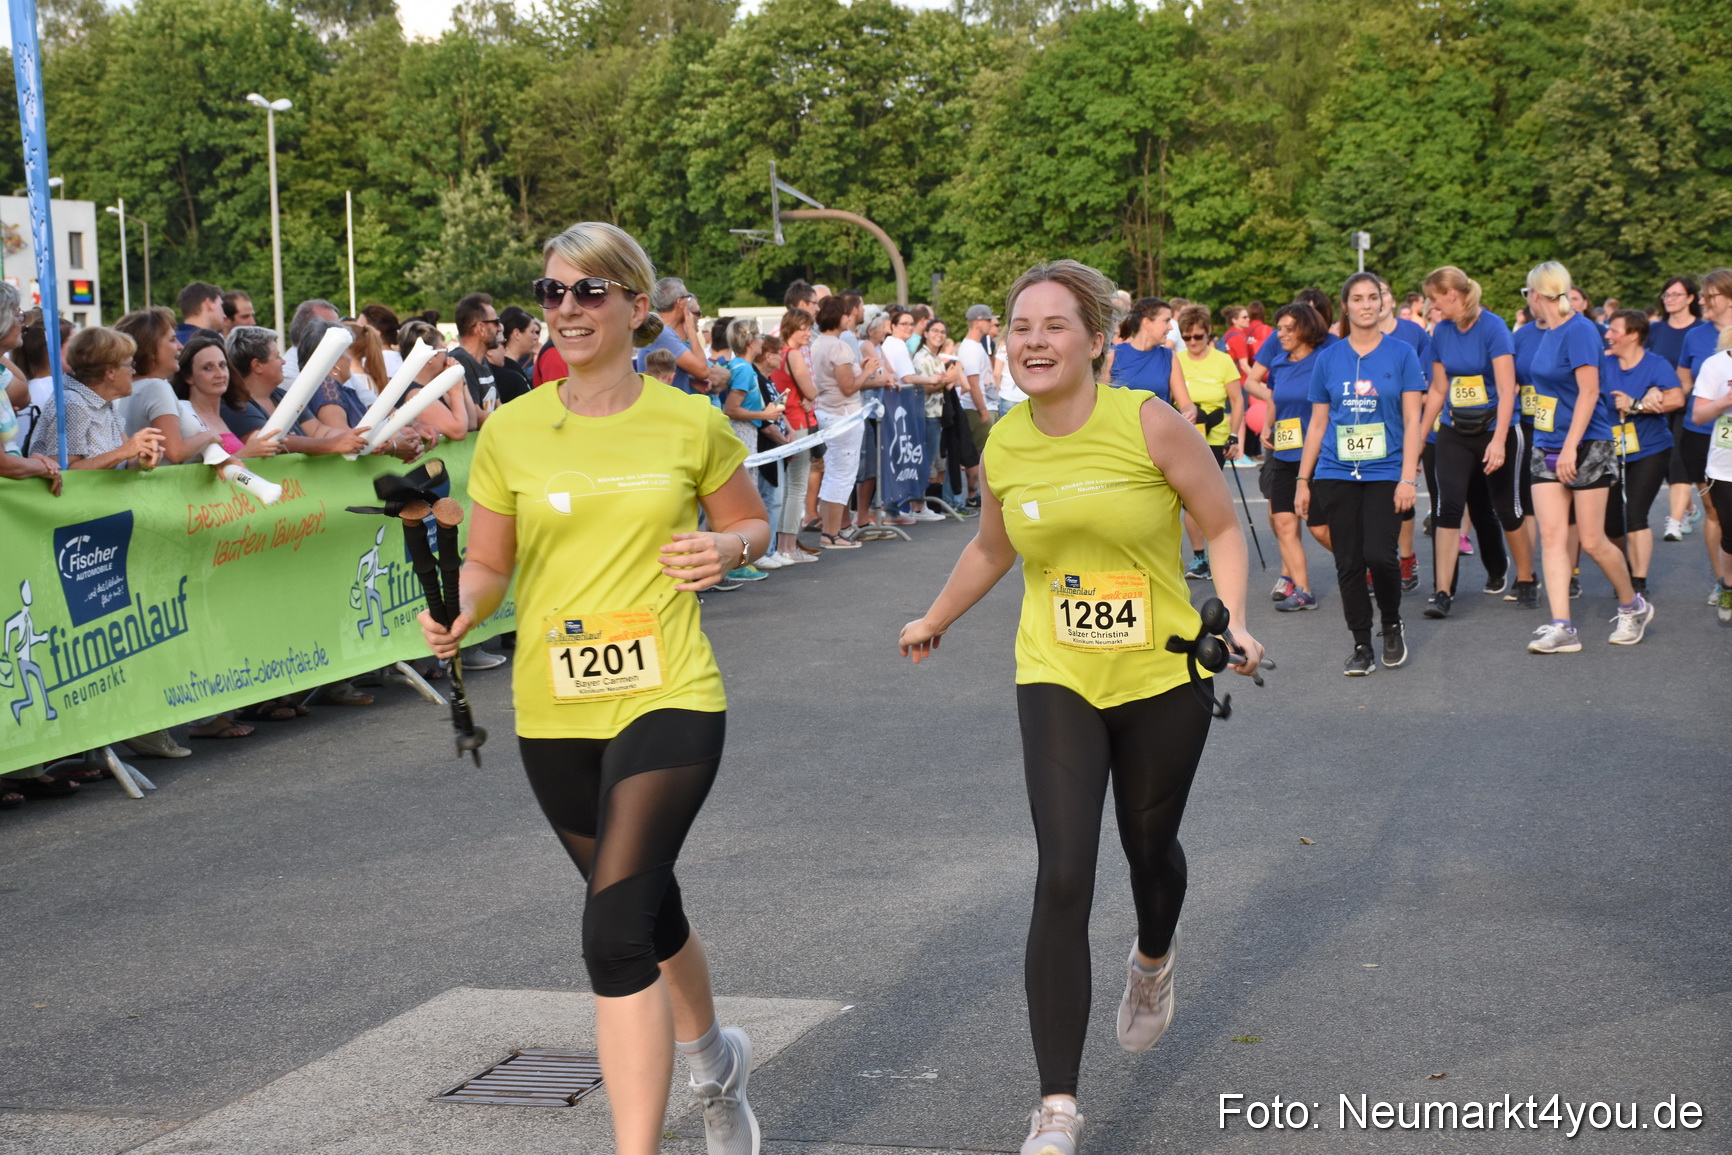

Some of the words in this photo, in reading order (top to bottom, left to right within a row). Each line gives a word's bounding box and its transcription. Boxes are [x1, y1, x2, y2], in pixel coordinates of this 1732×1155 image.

[1342, 382, 1351, 397] I
[1455, 387, 1477, 399] 856
[1342, 398, 1378, 408] camping
[1276, 430, 1294, 443] 862
[1347, 437, 1375, 451] 847
[187, 485, 256, 535] Gesunde
[212, 525, 267, 567] laufen
[68, 545, 119, 573] Fischer
[75, 562, 114, 582] AUTOMOBILE
[1060, 585, 1097, 596] firmenlauf
[1101, 590, 1121, 600] walk
[1122, 591, 1144, 600] 2019
[1060, 599, 1137, 630] 1284
[47, 575, 189, 687] firmenlauf
[1068, 629, 1089, 638] Salzer
[1091, 630, 1129, 639] Christina
[560, 639, 645, 679] 1201
[163, 641, 329, 707] www.firmenlauf-oberpfalz.de
[63, 666, 127, 710] neumarkt
